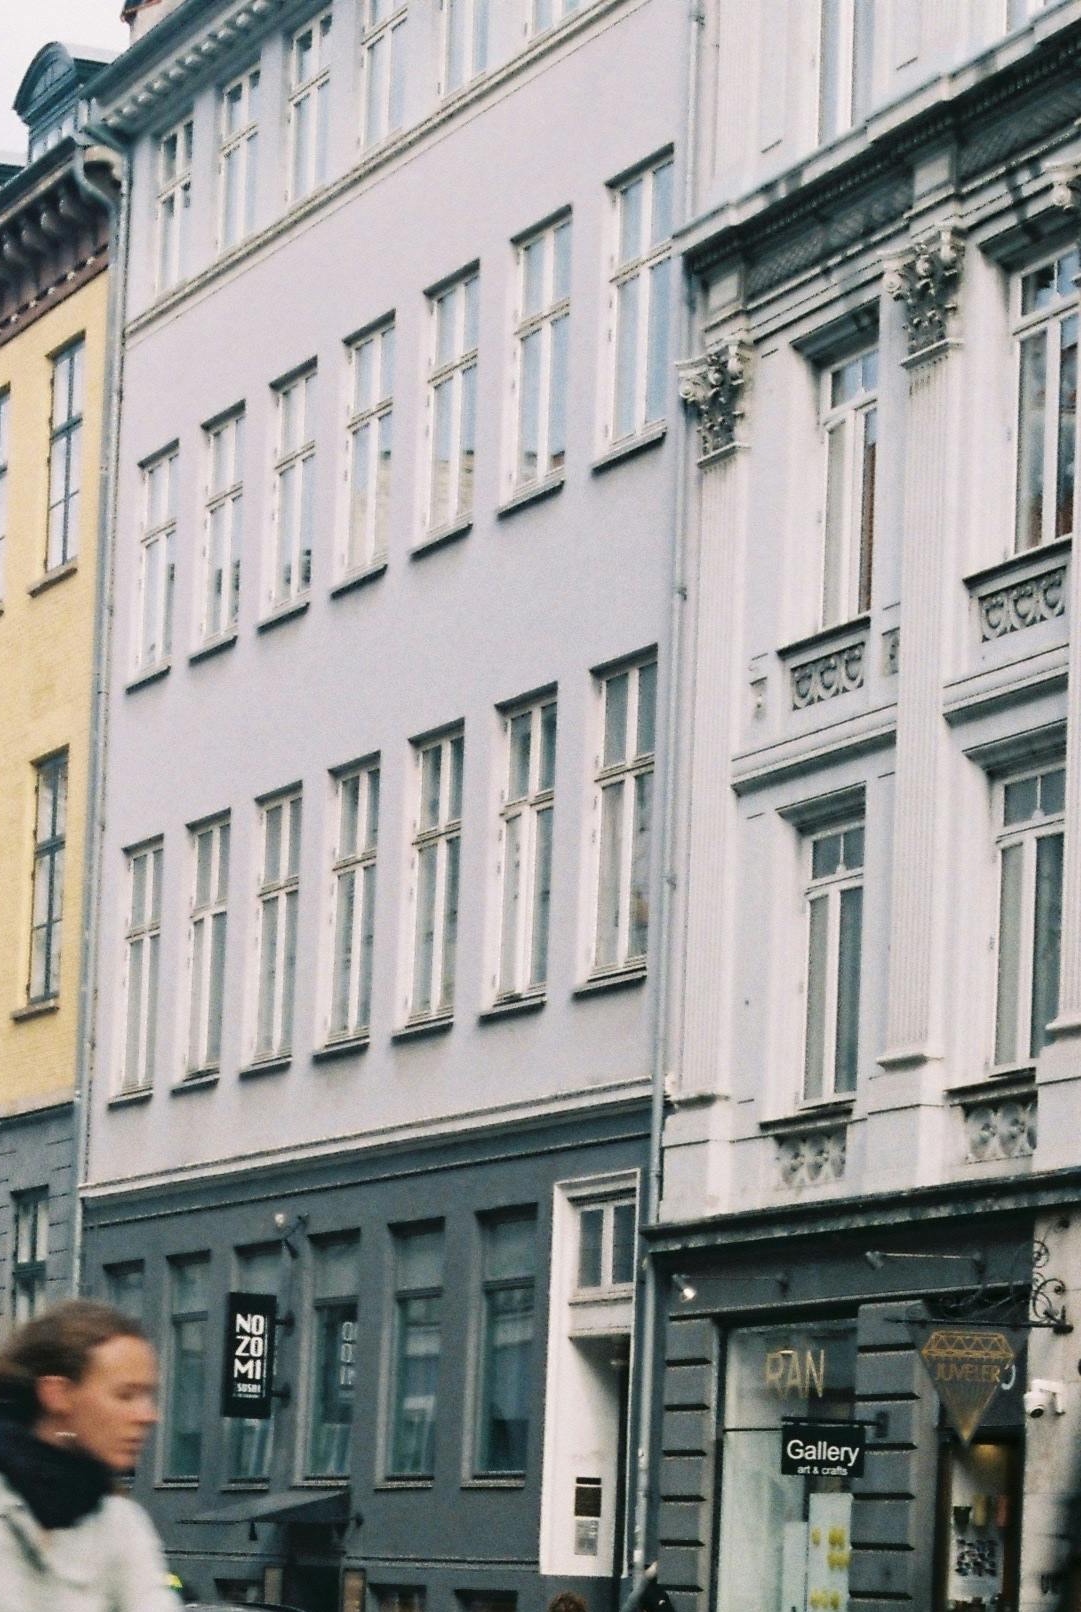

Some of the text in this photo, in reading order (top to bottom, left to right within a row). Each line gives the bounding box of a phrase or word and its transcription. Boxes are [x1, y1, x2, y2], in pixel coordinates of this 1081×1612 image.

[235, 1313, 265, 1336] NO
[234, 1335, 264, 1357] ZO
[233, 1358, 262, 1380] MI
[786, 1439, 860, 1467] Gallery
[797, 1466, 848, 1476] art & crafts
